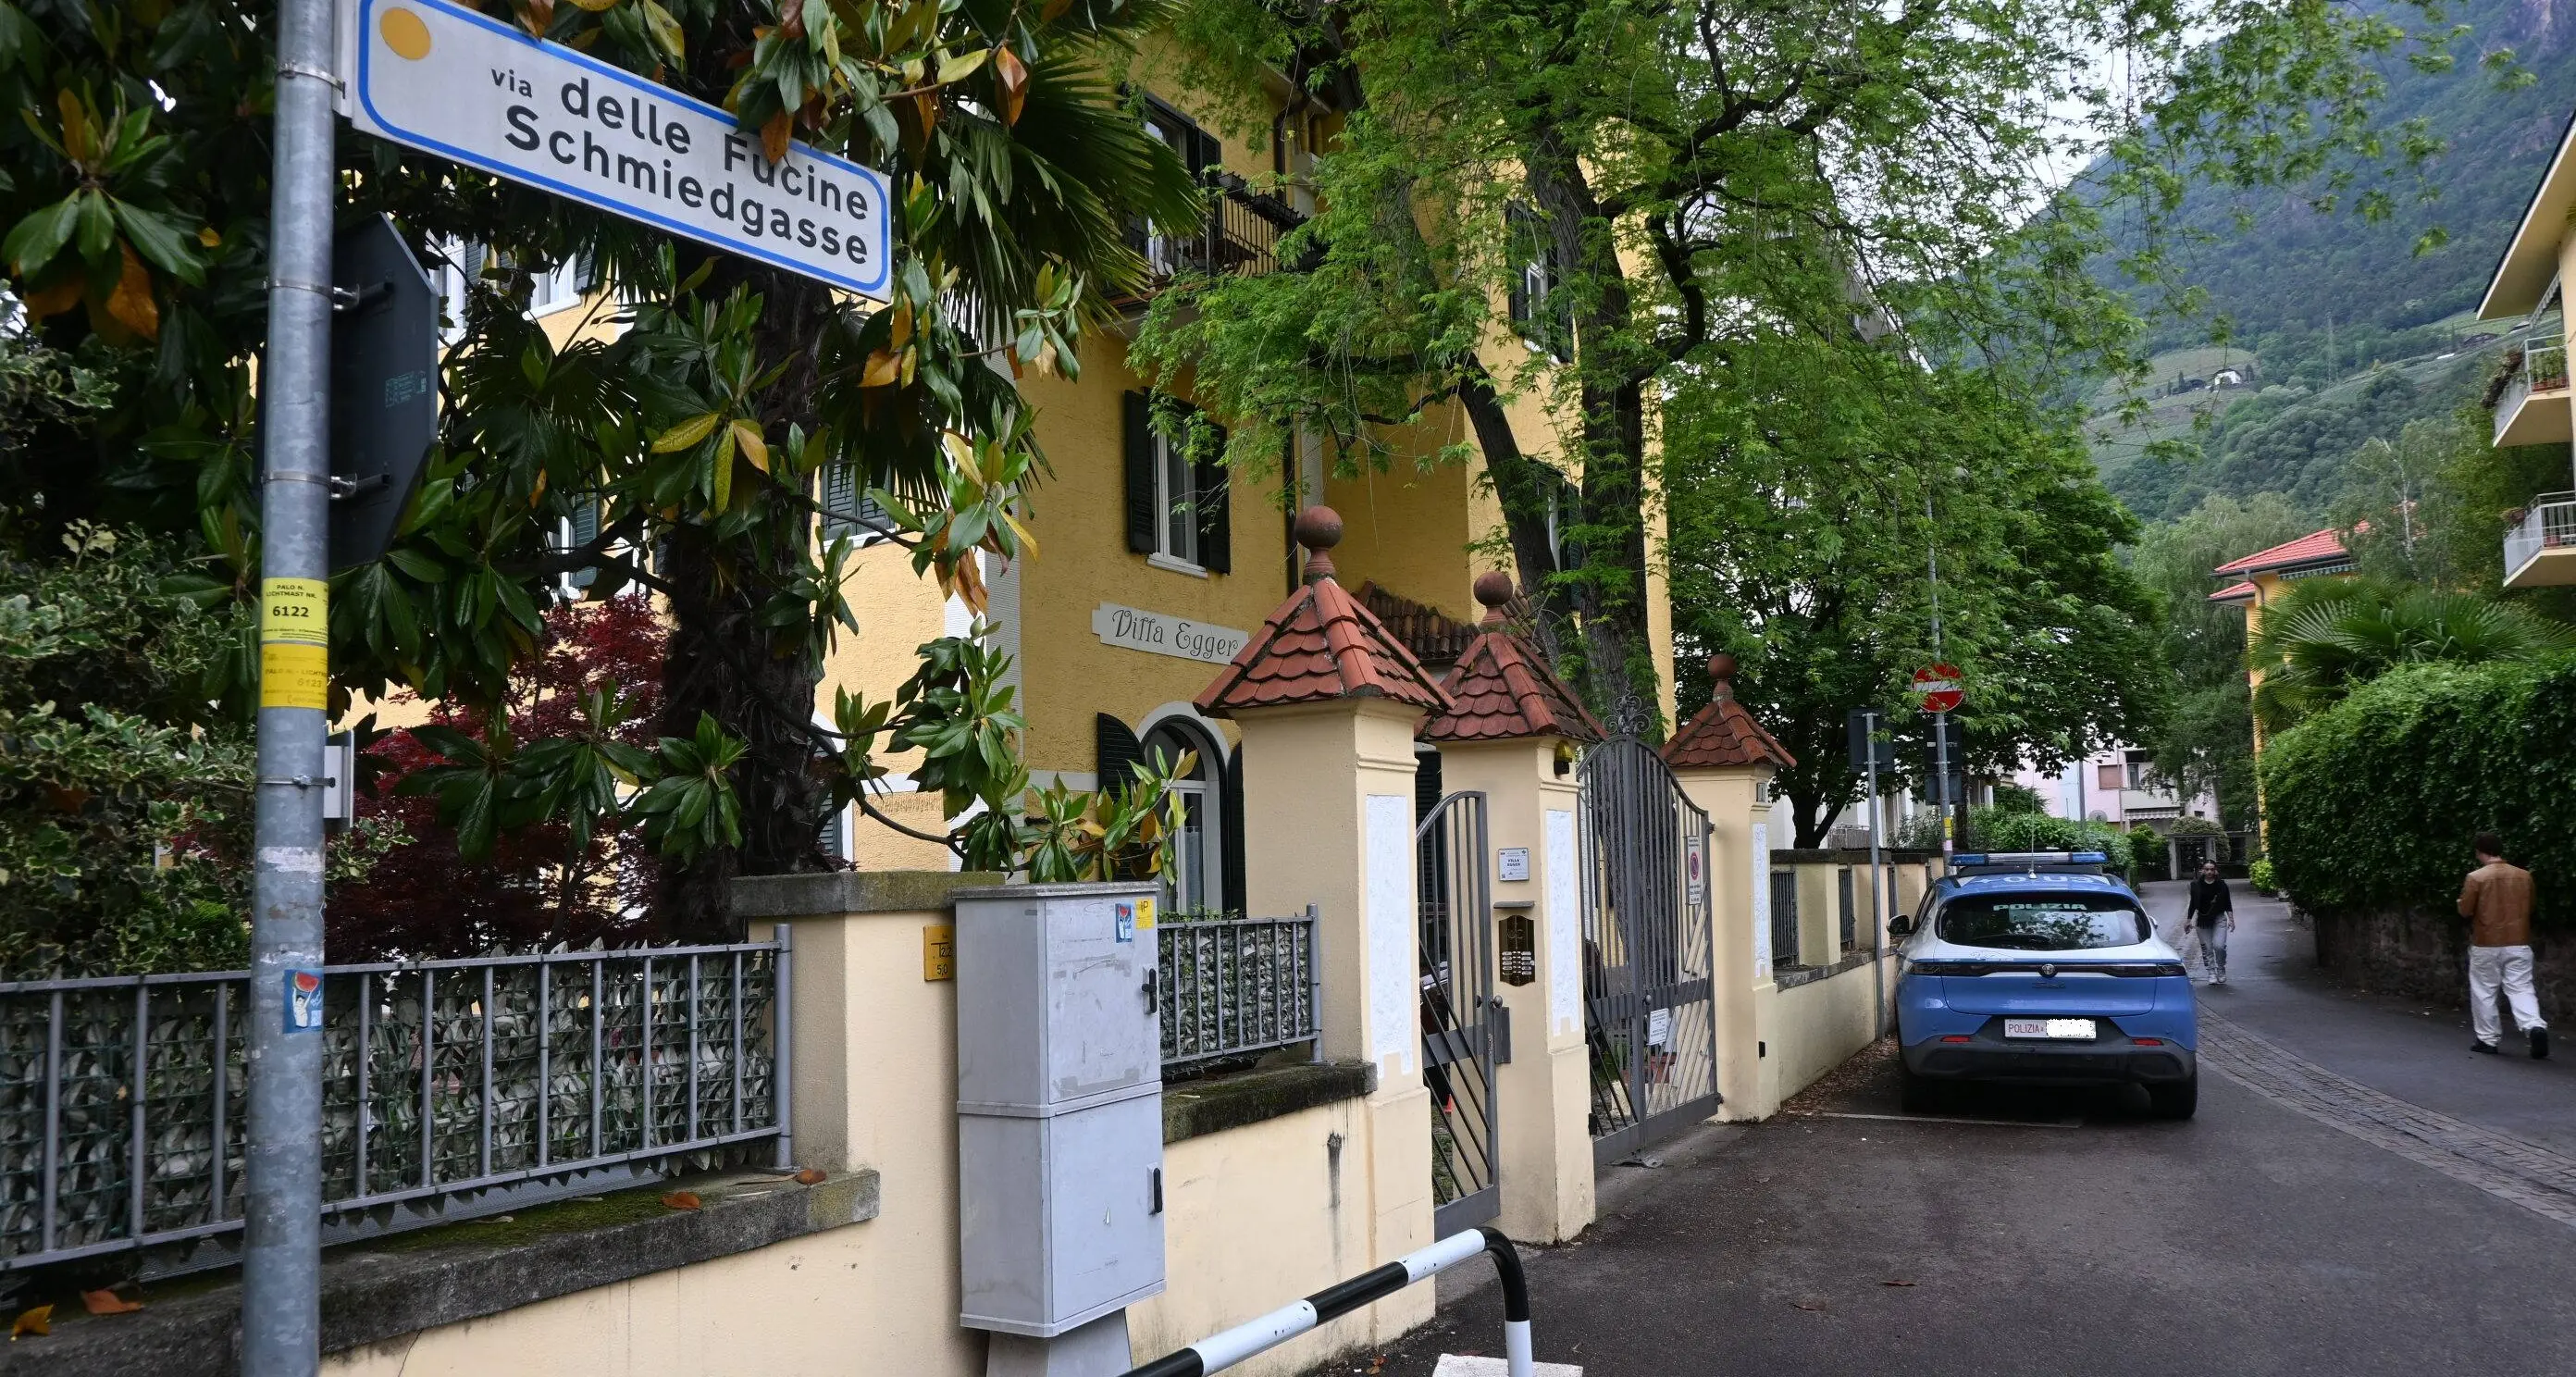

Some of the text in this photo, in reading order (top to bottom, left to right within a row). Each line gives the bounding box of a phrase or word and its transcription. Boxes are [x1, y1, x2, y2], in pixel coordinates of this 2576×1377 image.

[491, 68, 869, 220] via delle Fucine
[504, 105, 868, 265] Schmiedgasse
[273, 605, 309, 617] 6122
[1112, 609, 1239, 659] Villa Egger
[2008, 1023, 2040, 1034] POLIZIA
